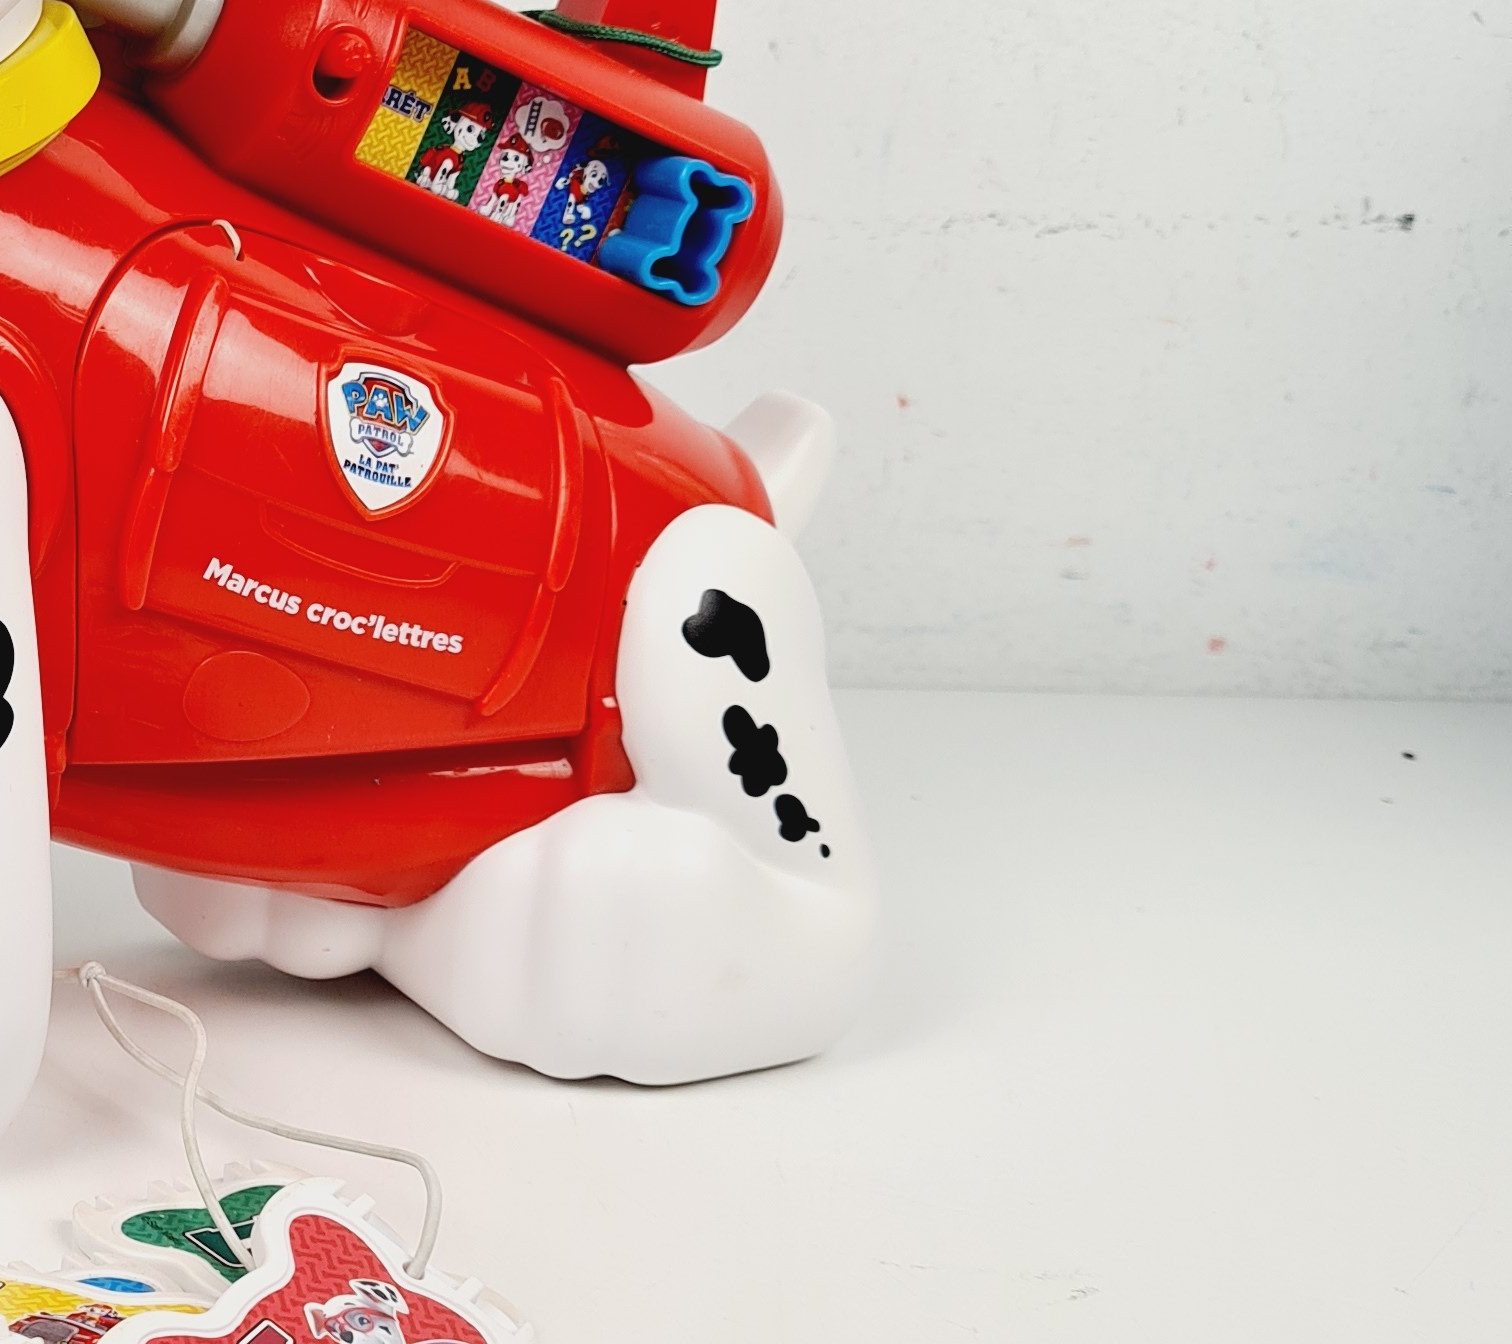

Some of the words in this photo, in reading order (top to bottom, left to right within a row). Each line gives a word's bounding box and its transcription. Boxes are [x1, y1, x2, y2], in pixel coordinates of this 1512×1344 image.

[452, 67, 473, 91] A
[382, 85, 433, 123] RÊT
[341, 380, 431, 435] PAW
[358, 423, 405, 447] PATROL
[343, 459, 412, 488] PATROUILLE
[359, 453, 373, 469] LA
[202, 556, 303, 615] Marcus
[306, 602, 464, 654] croc'lettres
